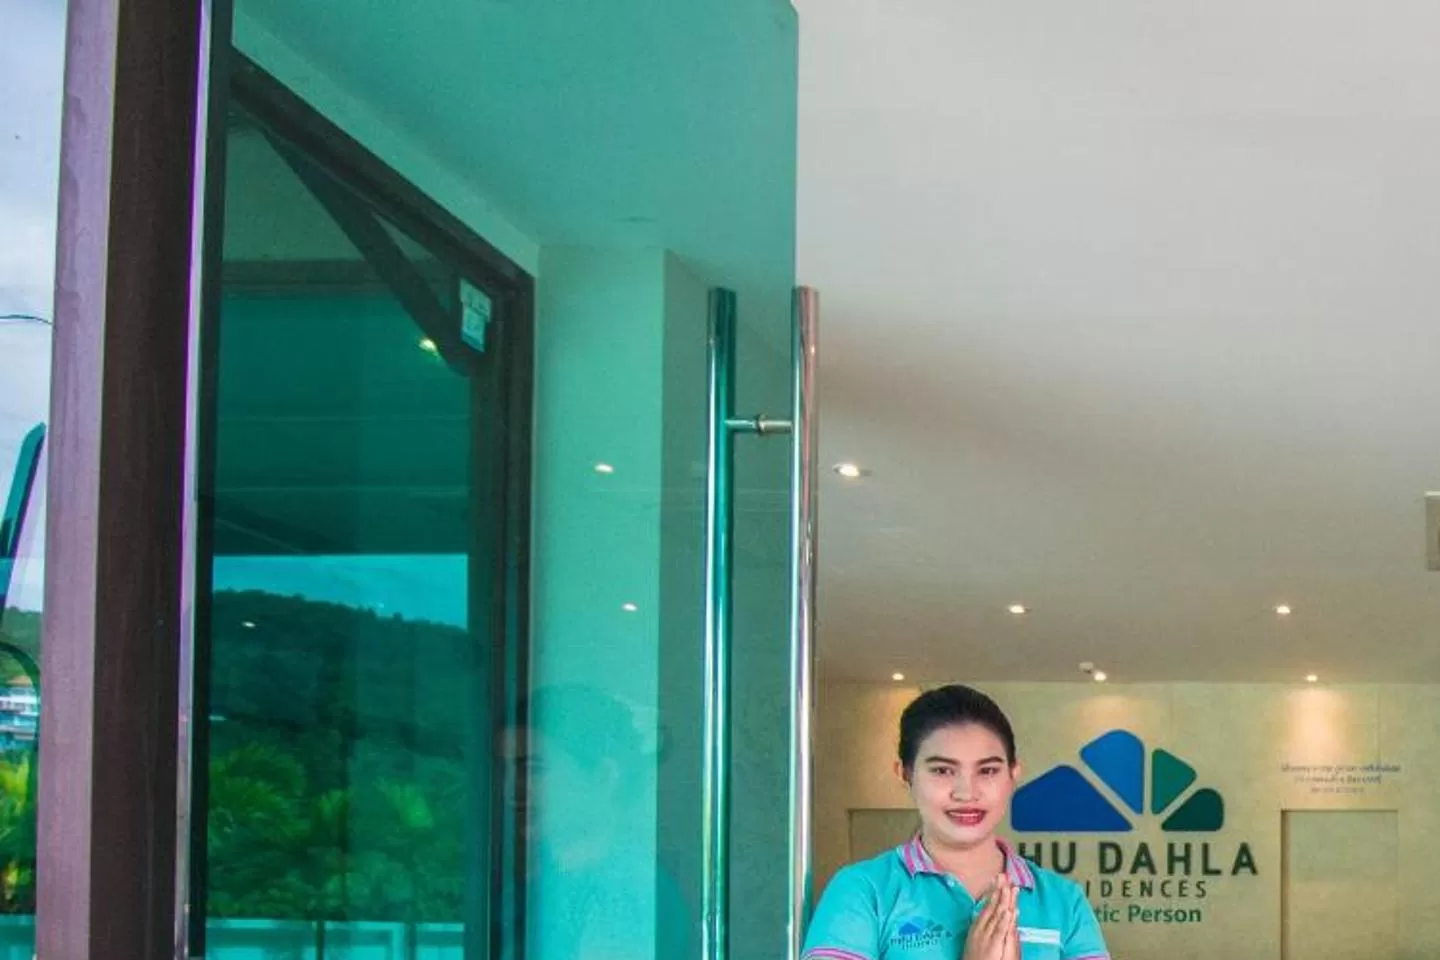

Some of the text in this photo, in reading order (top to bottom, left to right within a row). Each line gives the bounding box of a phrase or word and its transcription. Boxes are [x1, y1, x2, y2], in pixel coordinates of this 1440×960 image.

[1018, 841, 1259, 876] HU DAHLA
[1086, 880, 1207, 898] IDENCES
[1128, 904, 1202, 922] Person
